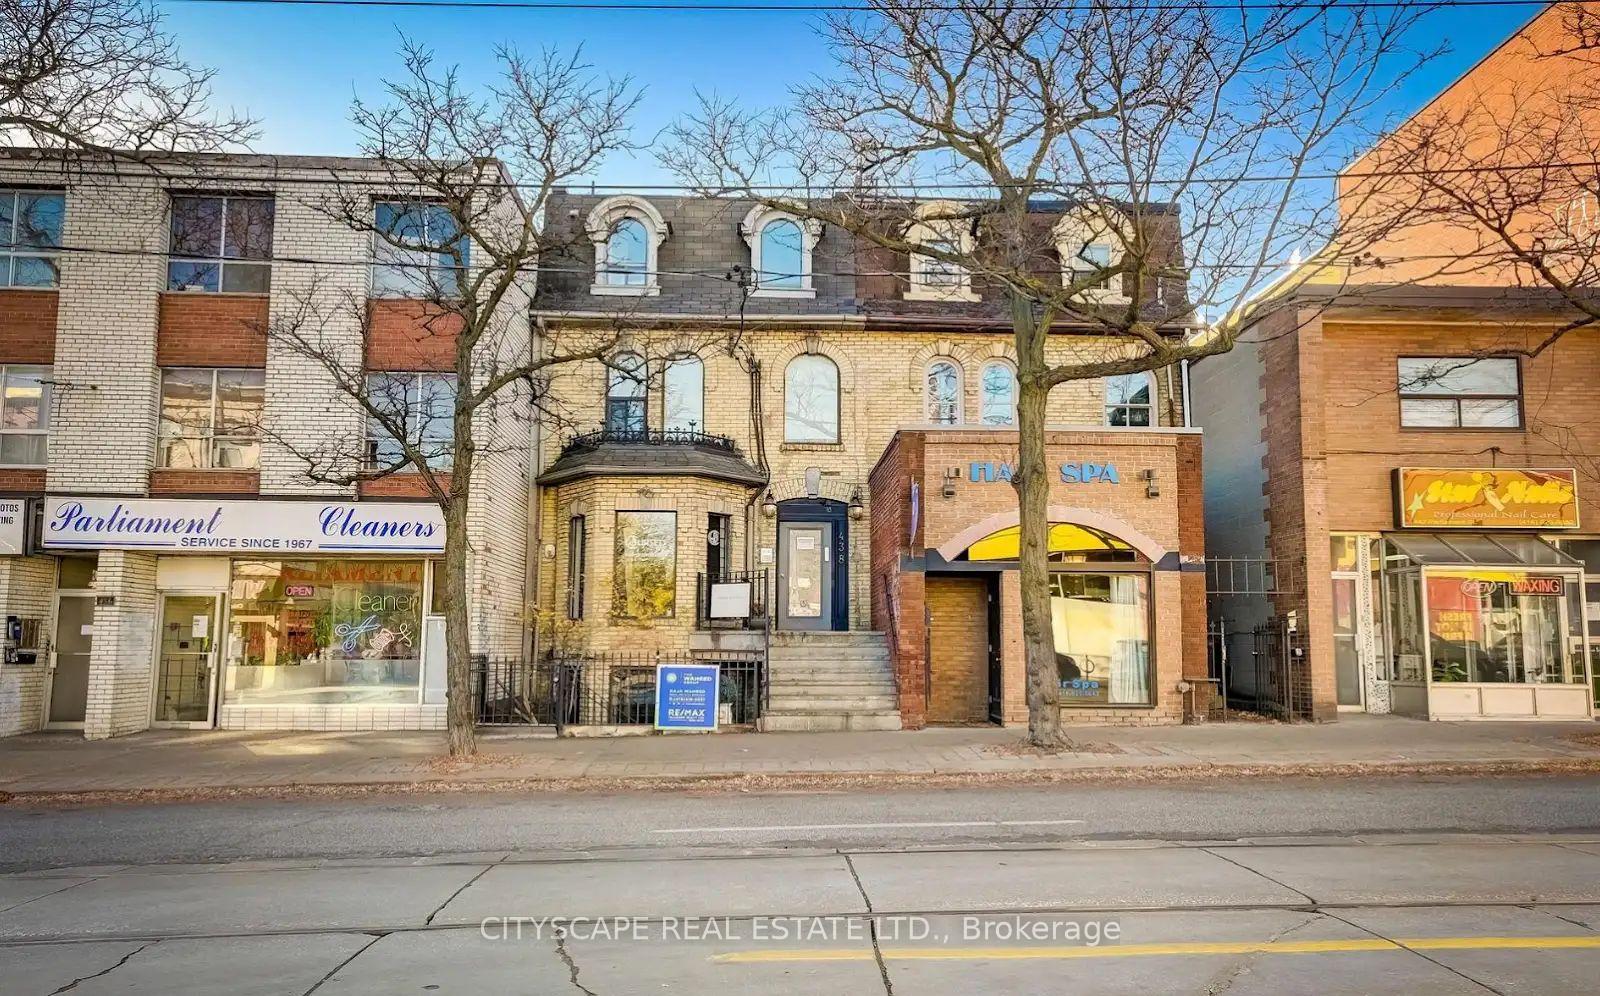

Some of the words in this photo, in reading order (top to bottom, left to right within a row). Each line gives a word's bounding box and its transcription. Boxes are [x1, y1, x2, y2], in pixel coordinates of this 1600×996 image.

[970, 462, 1012, 482] HA
[1060, 462, 1120, 484] SPA
[0, 503, 19, 512] OTOS
[0, 516, 14, 524] ING
[50, 501, 222, 534] Parliament
[319, 506, 440, 537] Cleaners
[181, 537, 236, 548] SERVICE
[241, 538, 280, 548] SINCE
[284, 539, 313, 549] 1967
[286, 585, 313, 597] OPEN
[1464, 581, 1494, 592] OPEN
[1512, 579, 1560, 593] WAXING
[668, 708, 705, 717] RE/MAX
